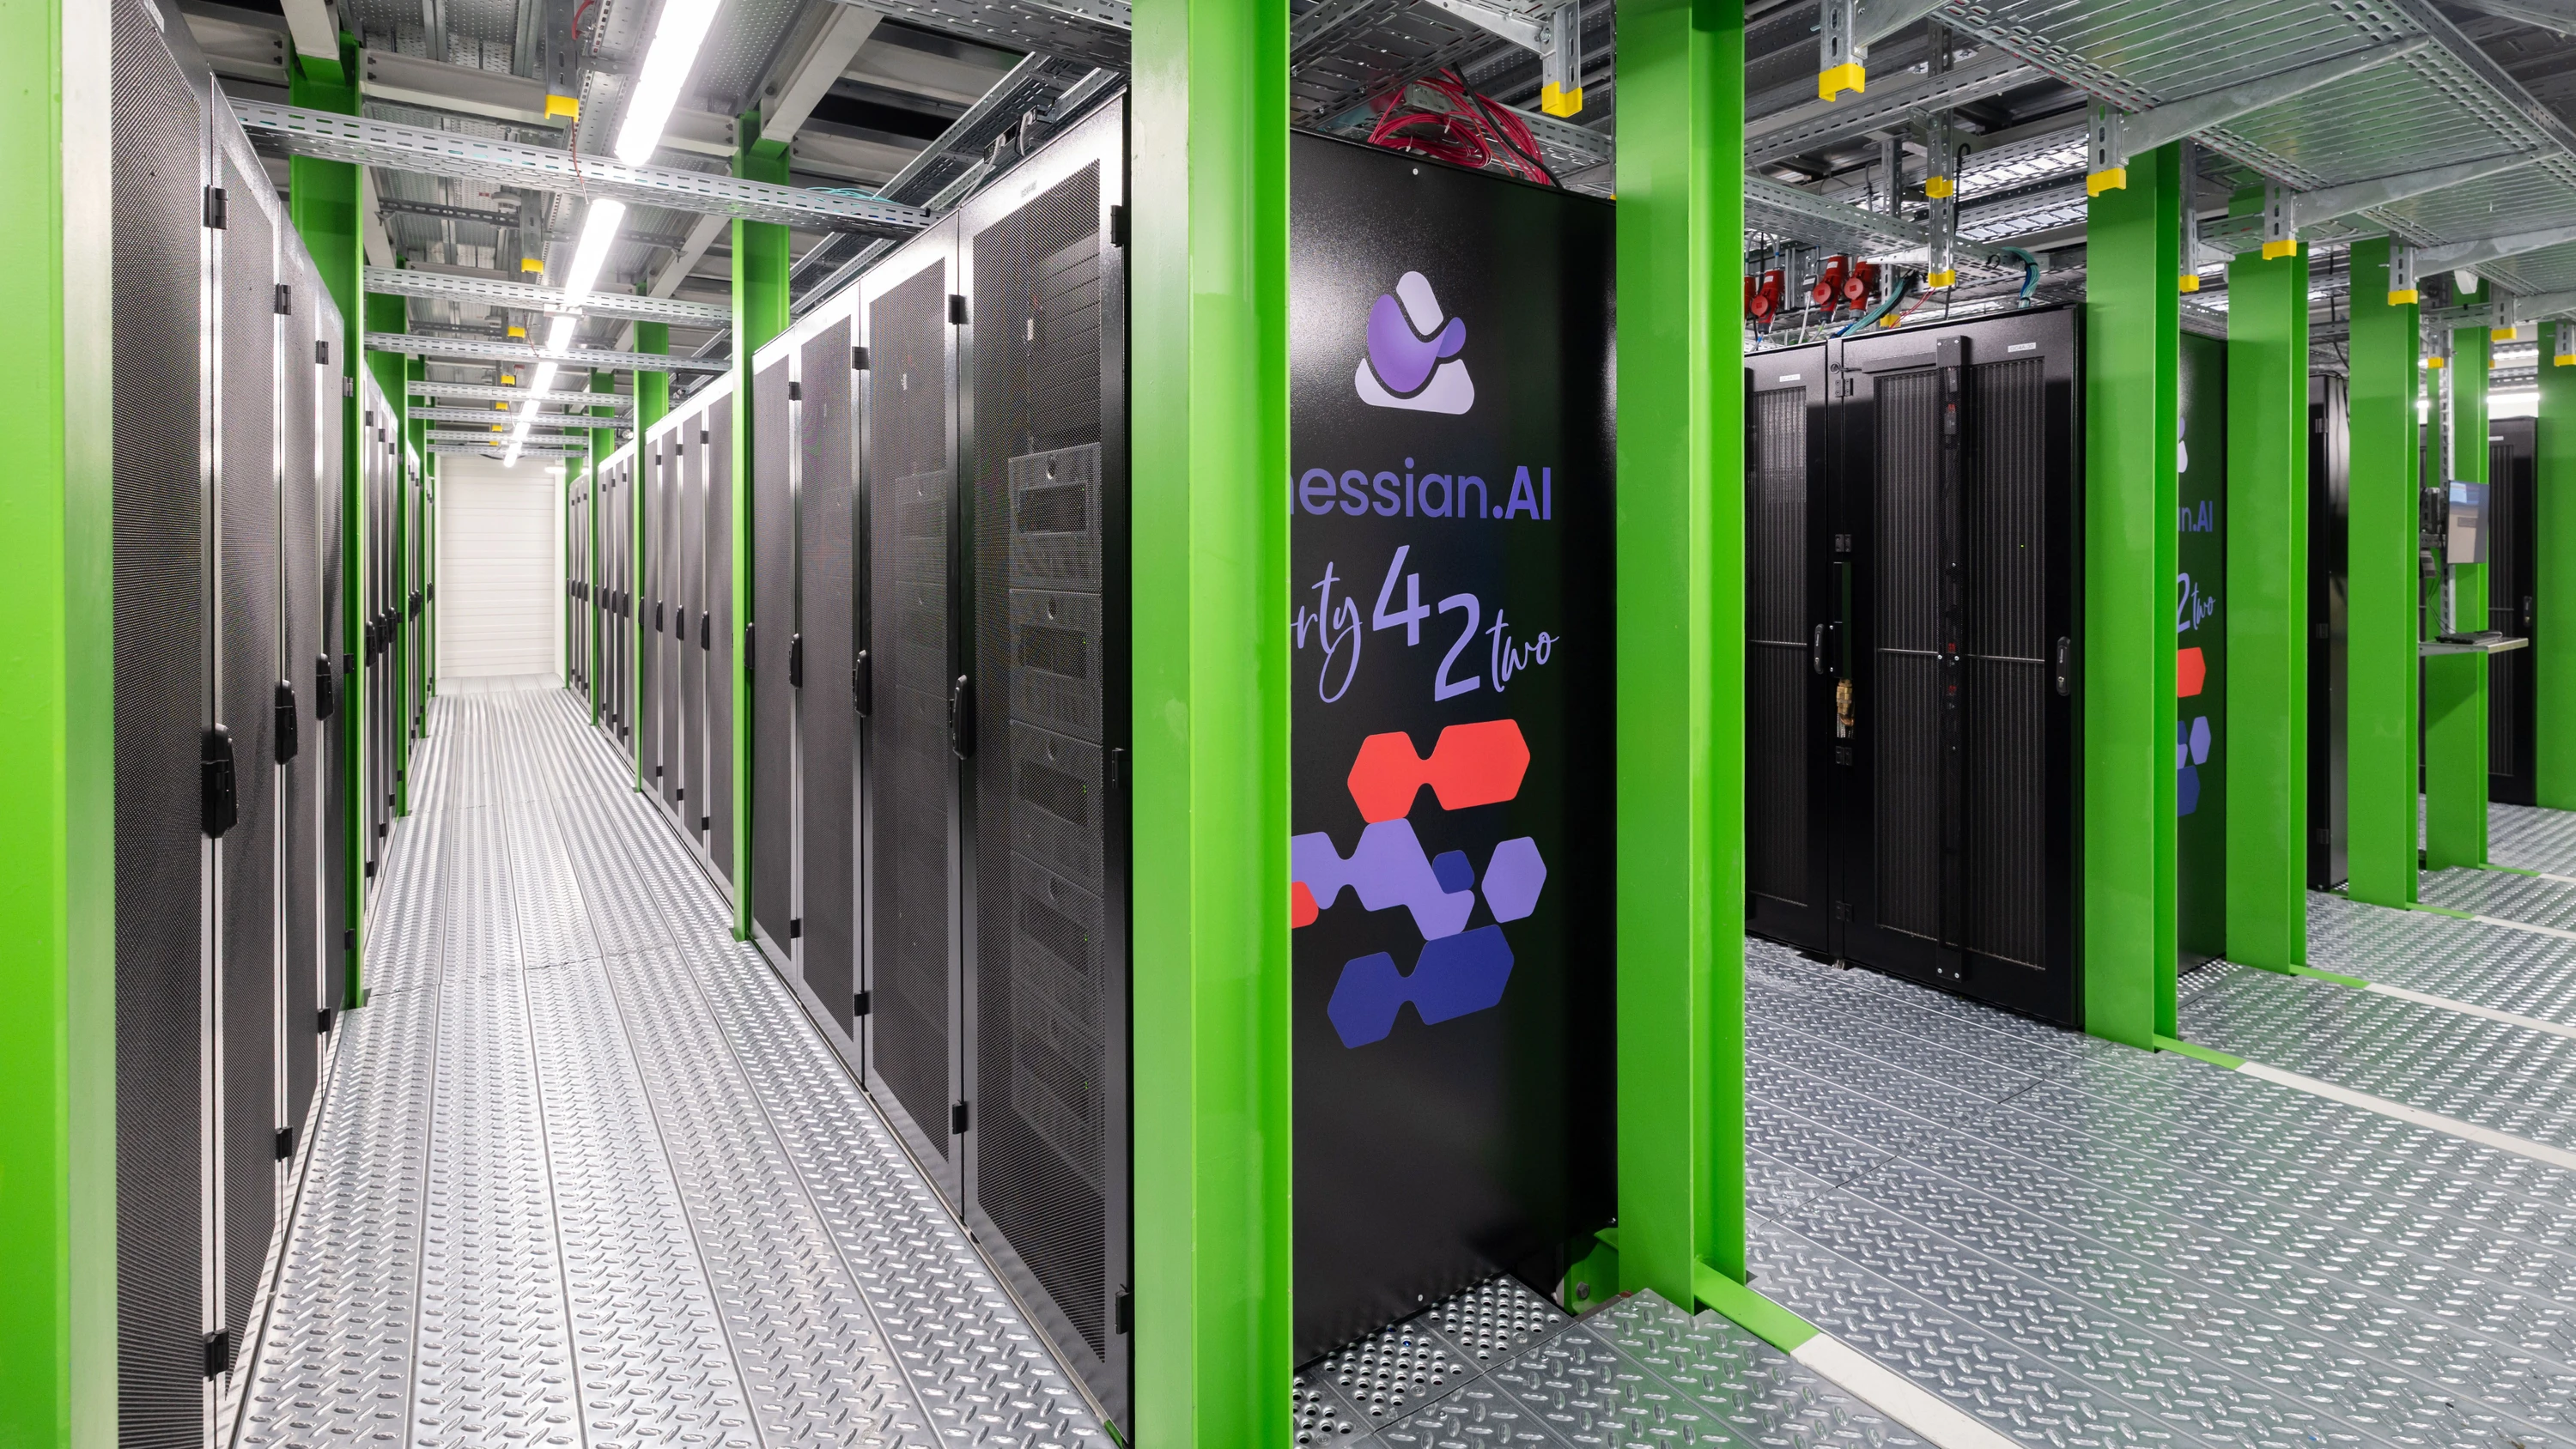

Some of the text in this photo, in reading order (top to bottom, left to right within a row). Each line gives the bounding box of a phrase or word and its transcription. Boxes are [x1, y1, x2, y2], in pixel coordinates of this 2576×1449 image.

[1291, 561, 1364, 703] rty
[1485, 609, 1559, 693] two
[2190, 582, 2215, 631] two
